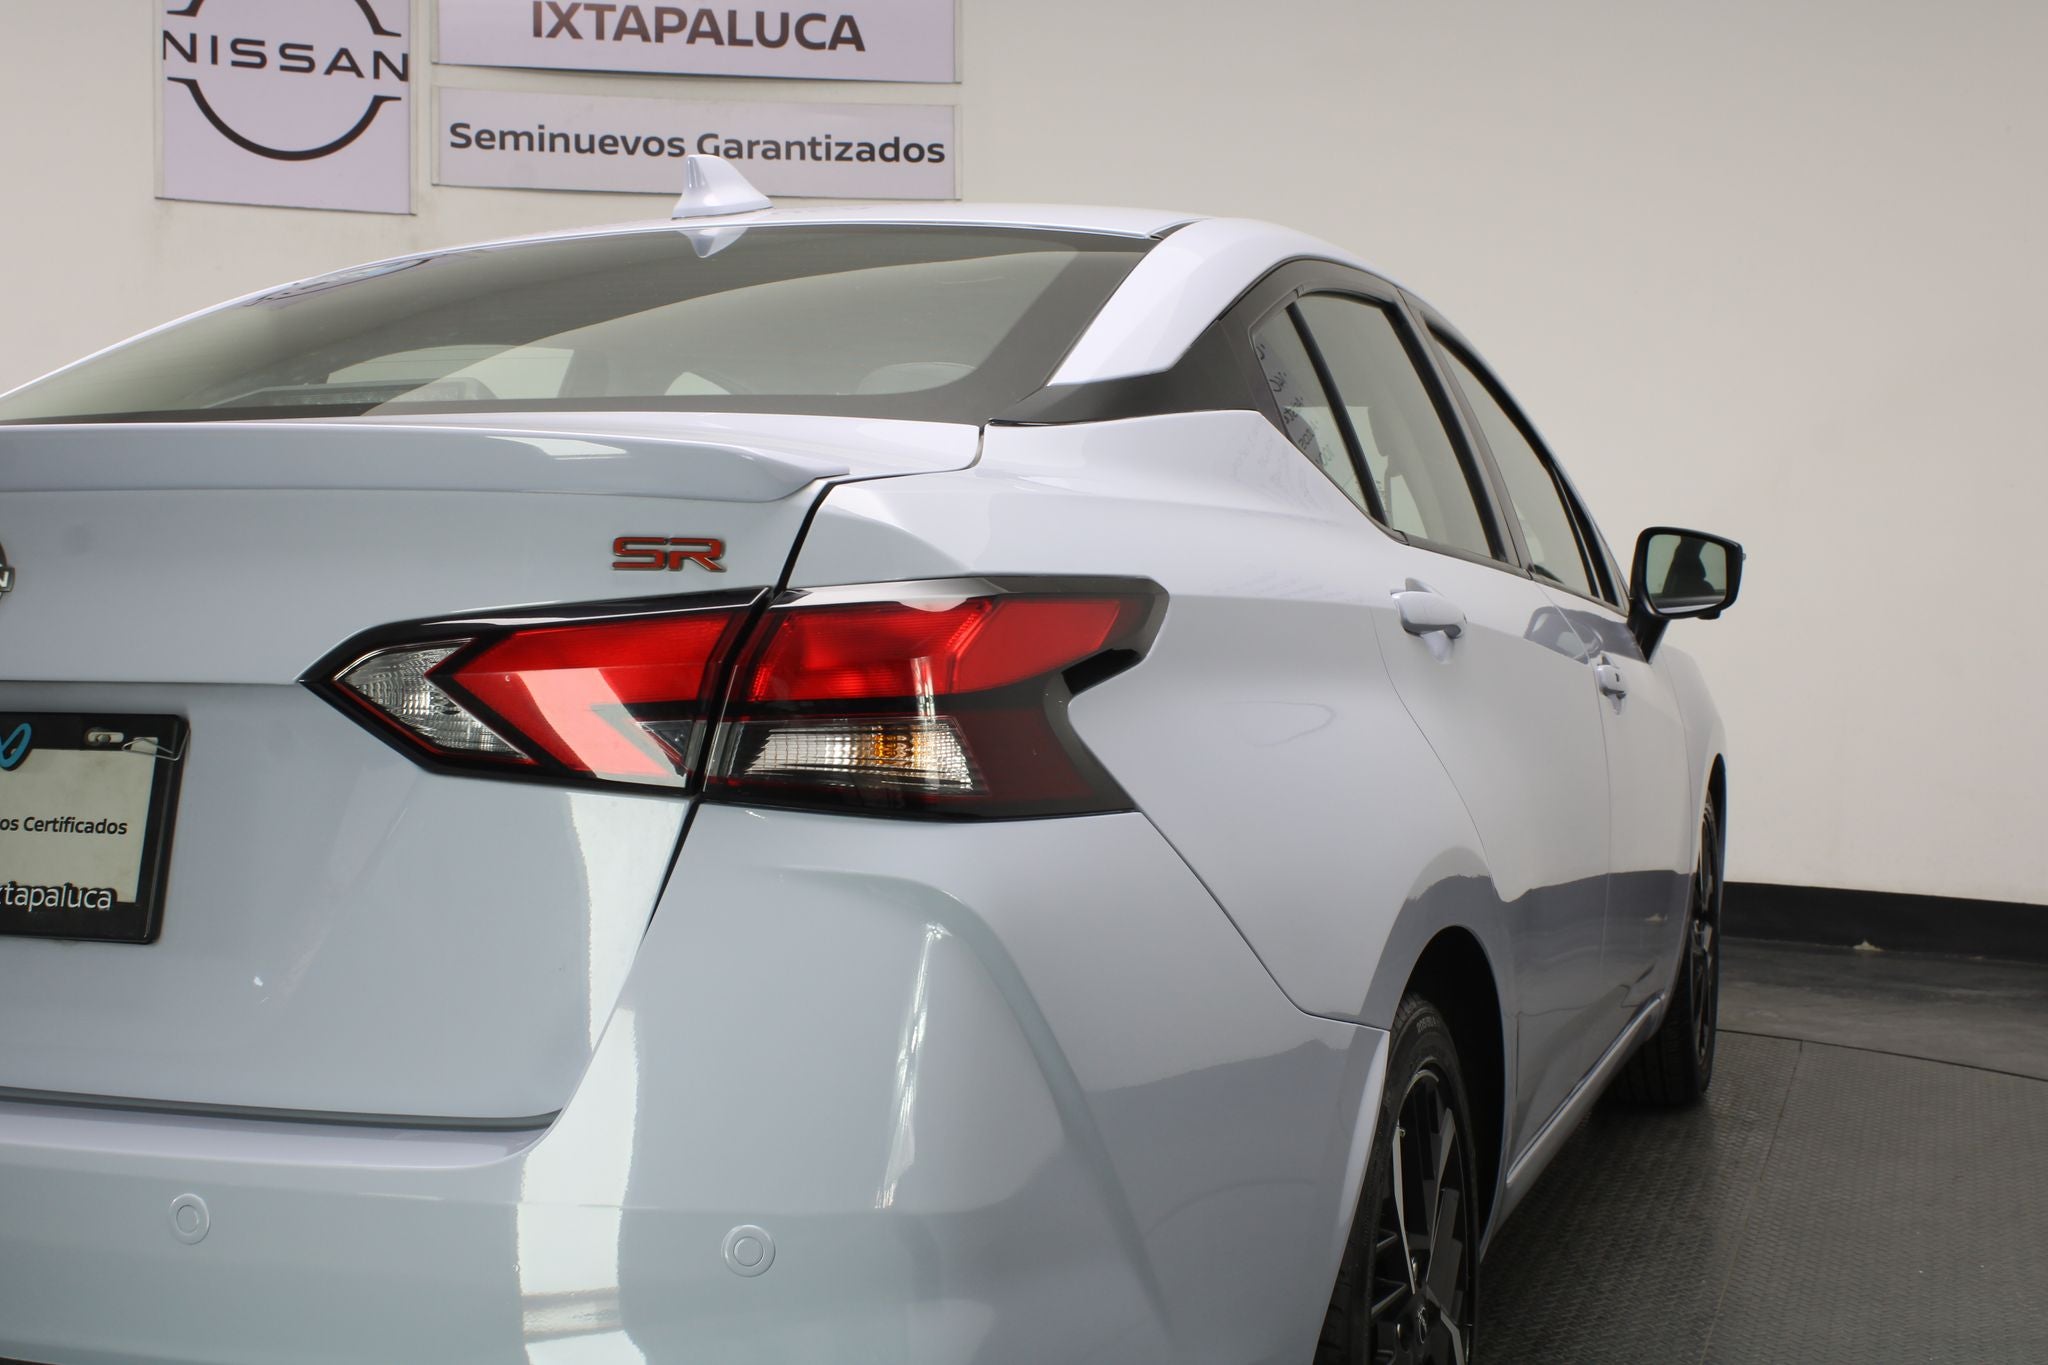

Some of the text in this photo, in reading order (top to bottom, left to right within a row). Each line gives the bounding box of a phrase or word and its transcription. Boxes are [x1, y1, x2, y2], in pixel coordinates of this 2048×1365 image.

[532, 1, 866, 52] IXTAPALUCA
[162, 30, 409, 82] NISSAN
[449, 122, 946, 163] Seminuevos Garantizados
[612, 537, 727, 572] SR
[23, 816, 128, 835] Certificados
